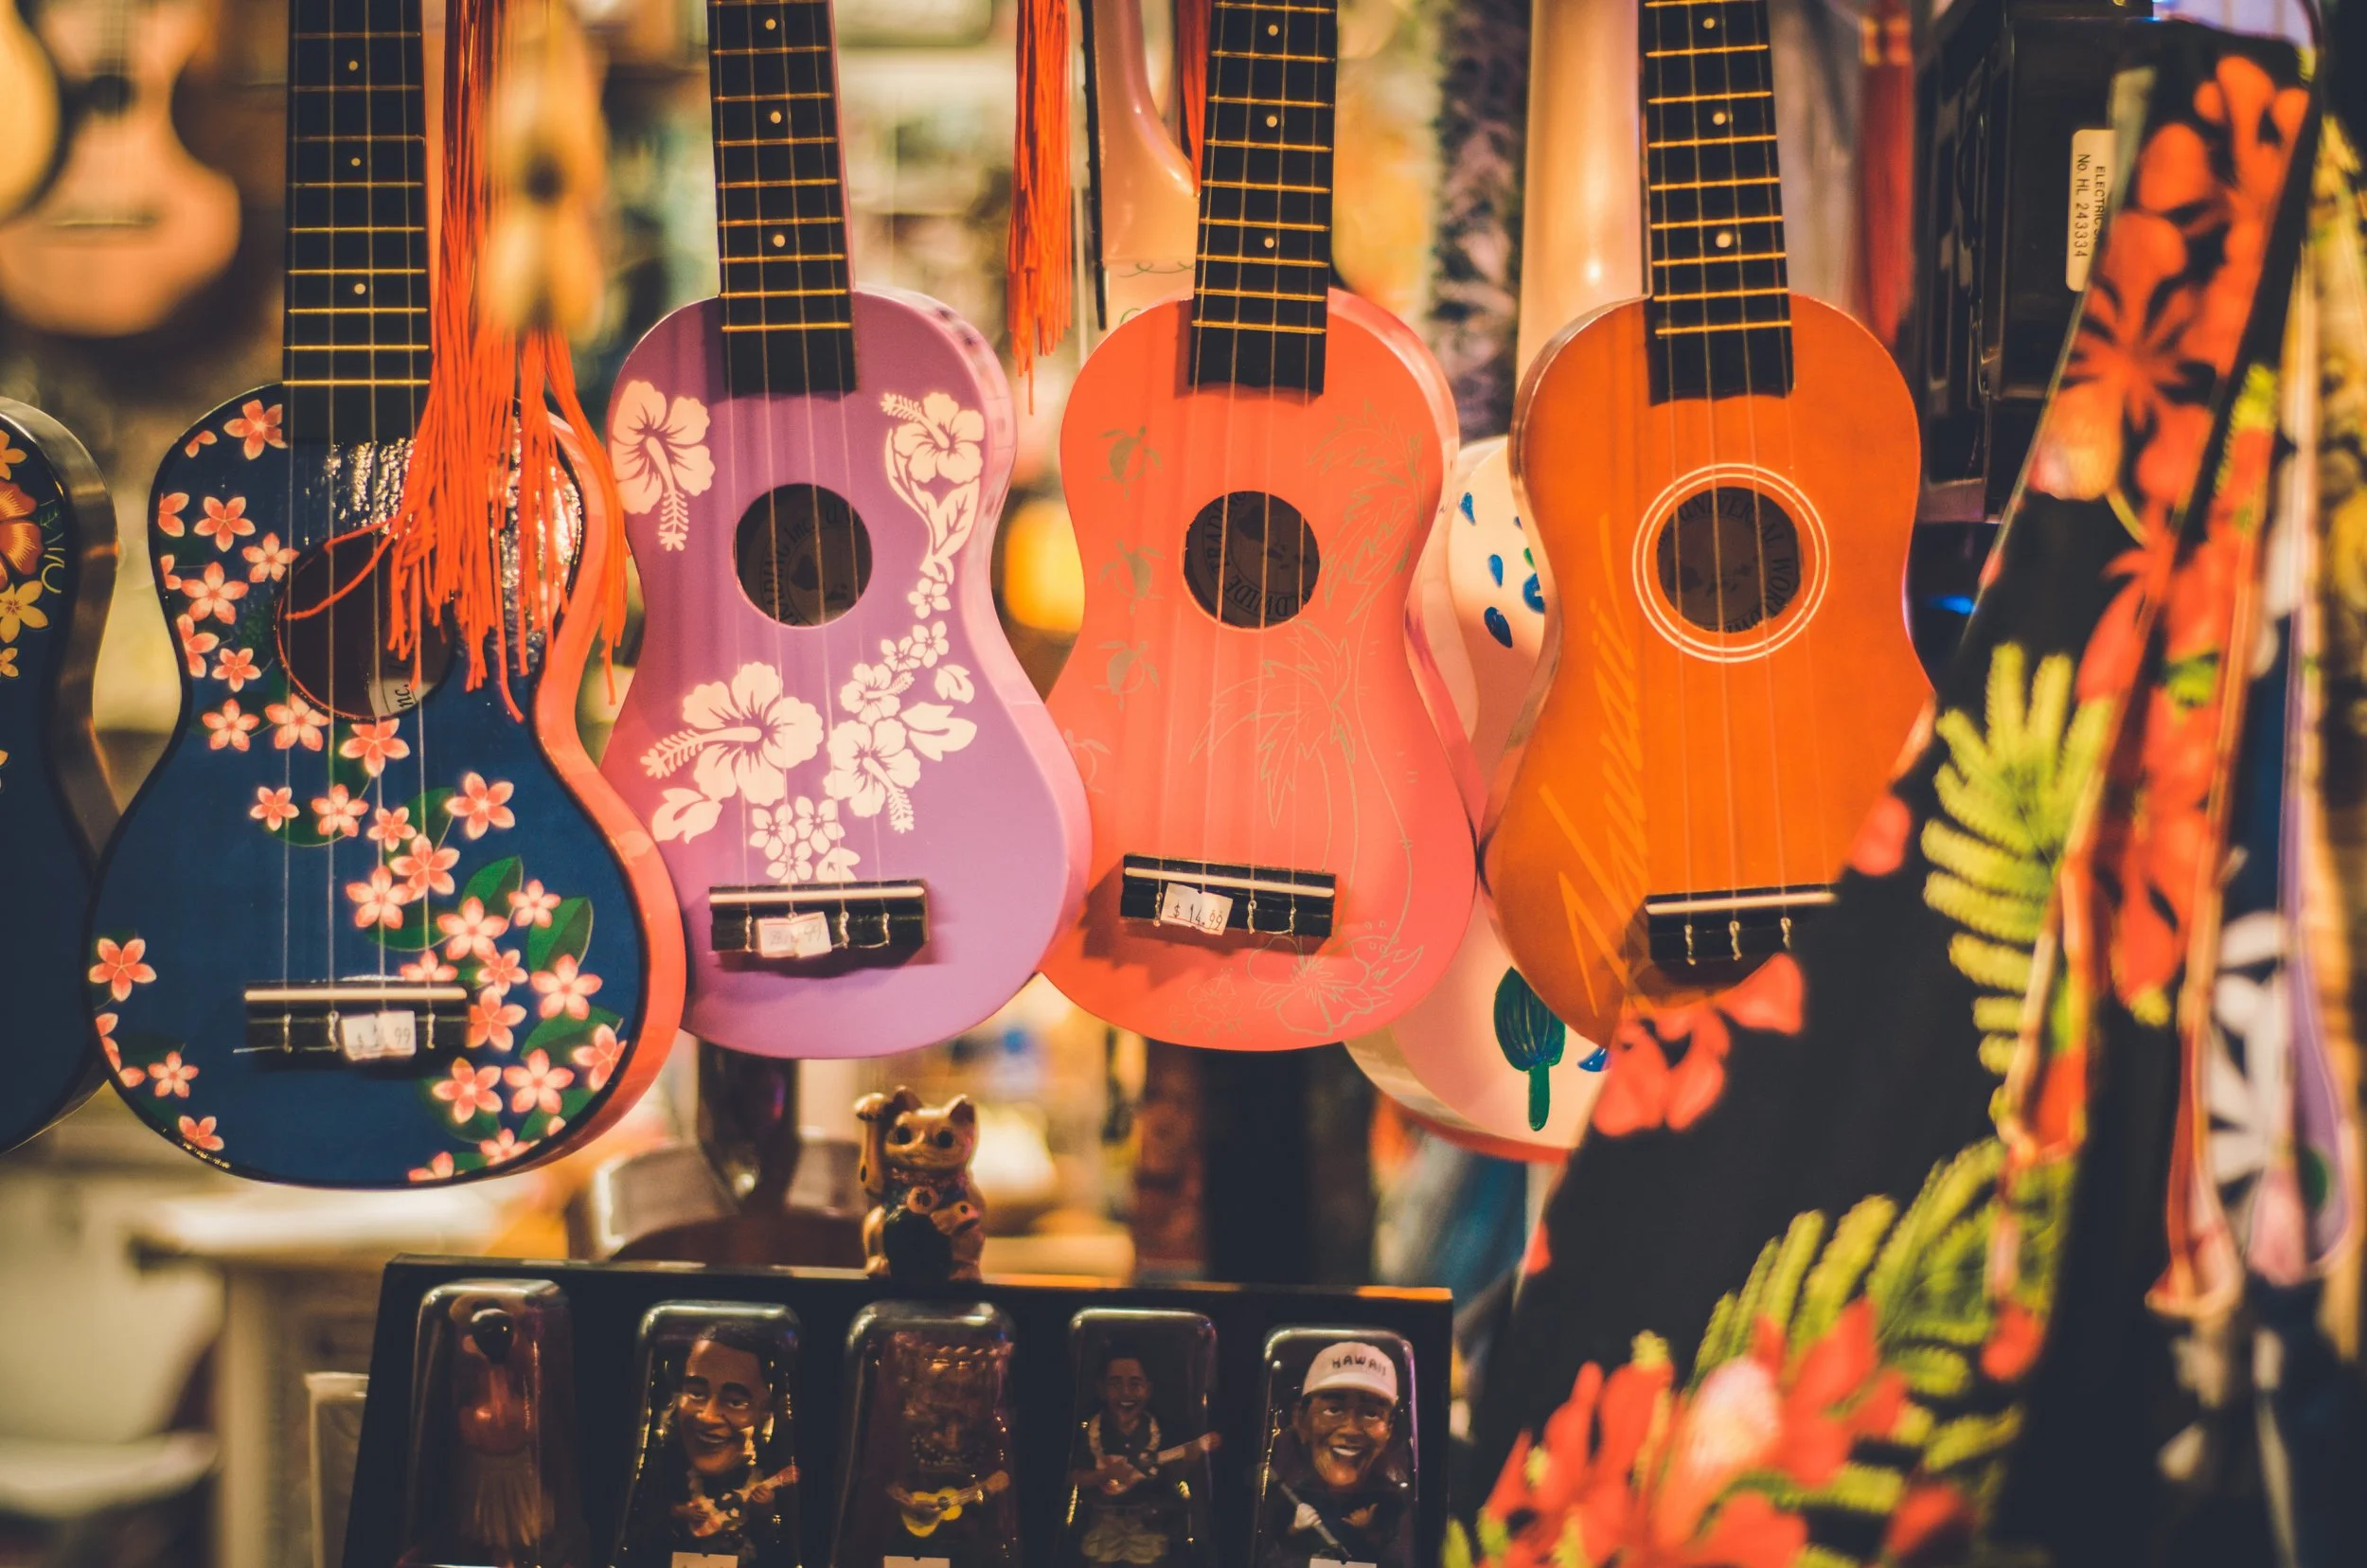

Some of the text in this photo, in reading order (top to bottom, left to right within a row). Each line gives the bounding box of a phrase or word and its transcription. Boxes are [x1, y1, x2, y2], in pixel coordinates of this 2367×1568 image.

[2092, 166, 2106, 225] ELECTRIC
[2073, 202, 2089, 258] 243334
[1189, 903, 1223, 931] 14.99
[1332, 1355, 1387, 1376] HAWAII
